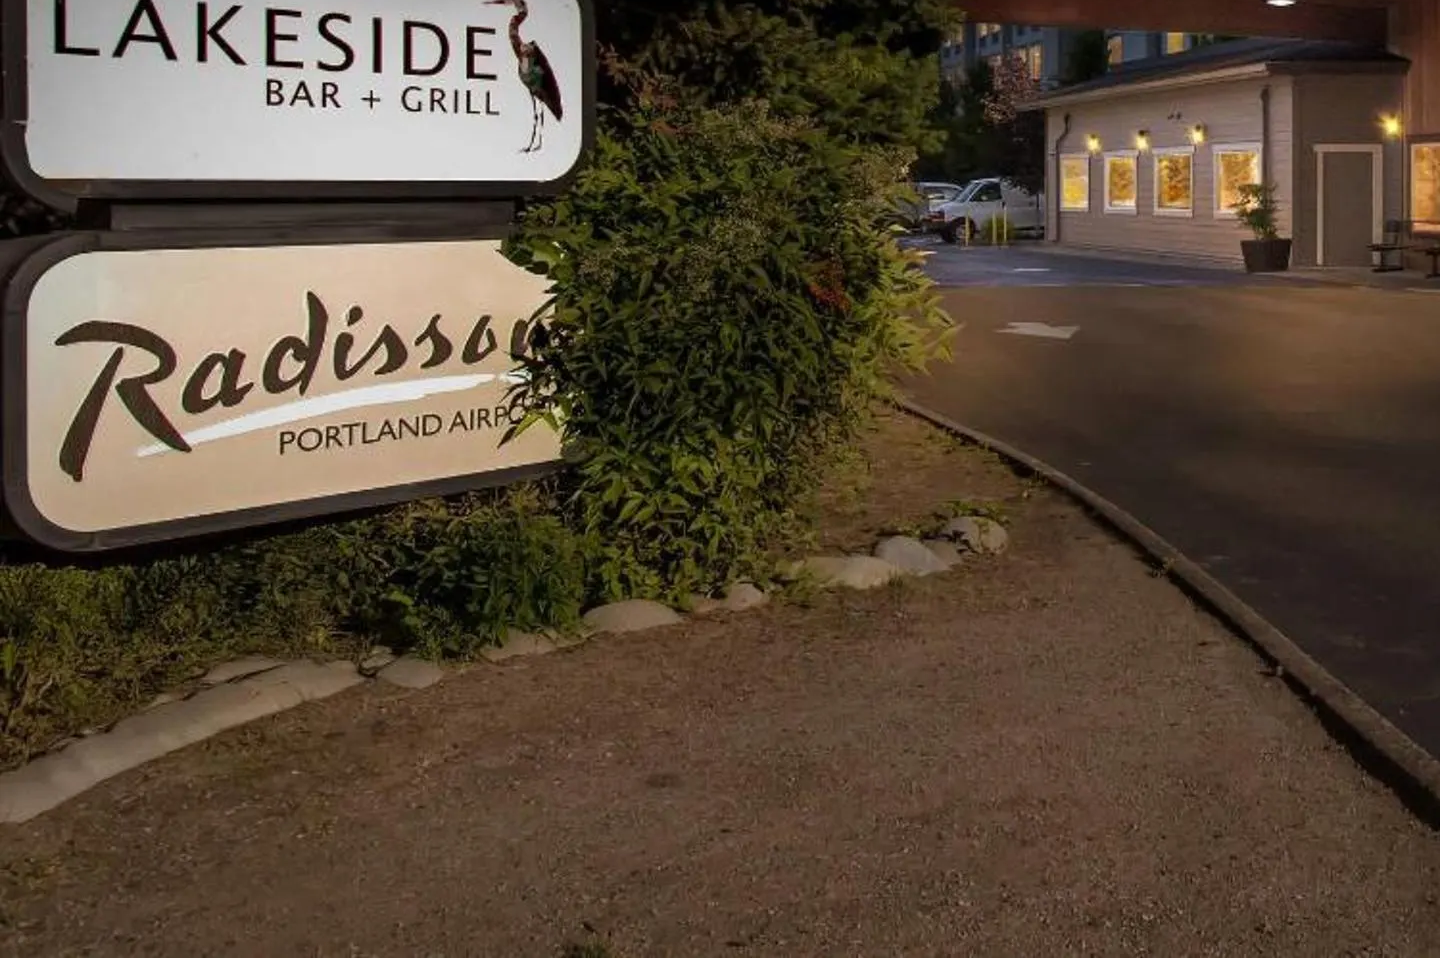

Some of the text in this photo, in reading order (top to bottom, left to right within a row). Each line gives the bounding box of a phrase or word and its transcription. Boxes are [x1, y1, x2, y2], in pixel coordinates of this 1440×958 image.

[265, 78, 500, 116] BAR + GRILL
[279, 413, 443, 455] PORTLAND
